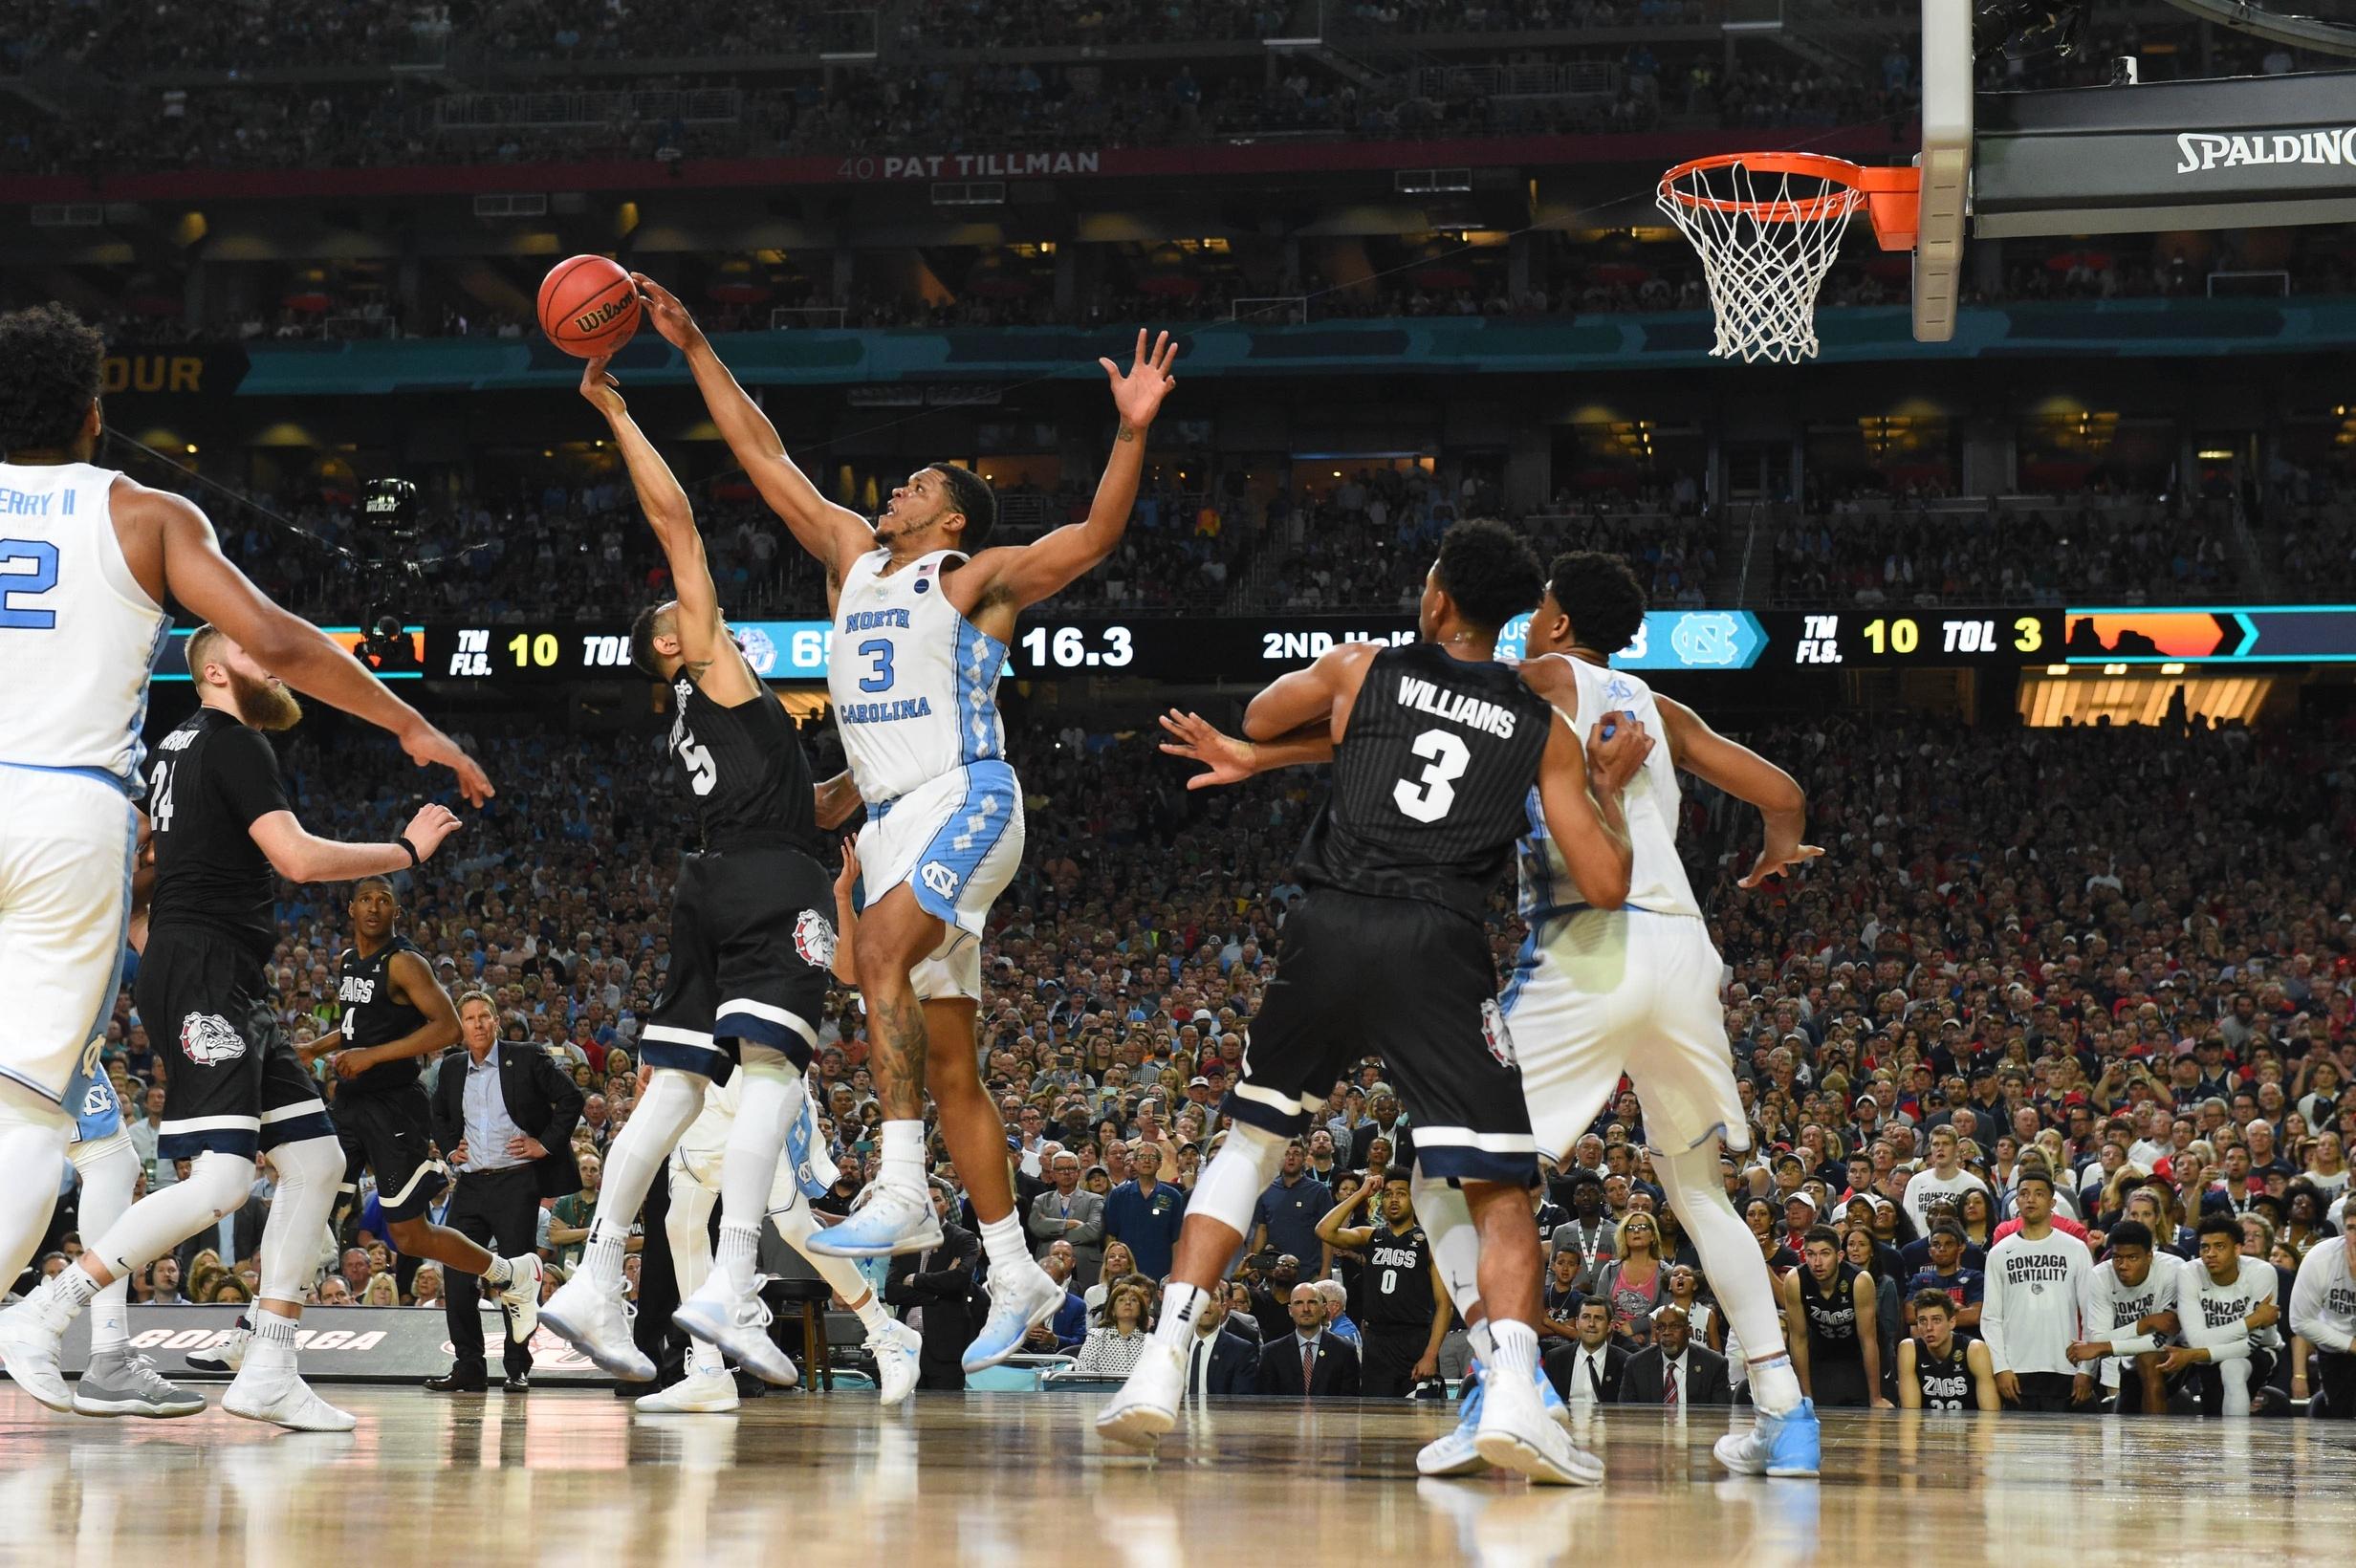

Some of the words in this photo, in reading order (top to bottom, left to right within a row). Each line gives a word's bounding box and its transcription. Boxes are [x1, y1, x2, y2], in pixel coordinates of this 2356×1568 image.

[838, 158, 874, 180] 40
[884, 156, 945, 178] PAT
[955, 152, 1100, 176] TILLMAN
[576, 291, 635, 333] Wilson
[845, 608, 910, 634] NORTH
[1804, 615, 1838, 639] TM
[1942, 621, 1996, 652] TOL
[2014, 617, 2042, 652] 3
[458, 629, 490, 652] TM
[1022, 626, 1133, 667] 16.3
[1263, 632, 1333, 659] 2ND
[1865, 619, 1918, 653] 10
[509, 633, 558, 667] 10
[582, 636, 632, 665] TOL
[1796, 640, 1843, 664] FLS.
[449, 653, 492, 676] FLS.
[859, 639, 894, 692] 3
[840, 697, 931, 724] CAROLINA
[1398, 675, 1516, 739] WILLIAMS
[678, 727, 717, 795] 5
[1393, 729, 1471, 823] 3
[150, 760, 176, 832] 24
[341, 1007, 356, 1040] 4
[1371, 1247, 1417, 1269] ZAGS
[2006, 1254, 2067, 1272] GONZAGA
[1381, 1269, 1397, 1295] 0
[2007, 1268, 2067, 1285] MENTALITY
[1810, 1305, 1855, 1325] ZAGS
[1923, 1375, 1968, 1397] ZAGS
